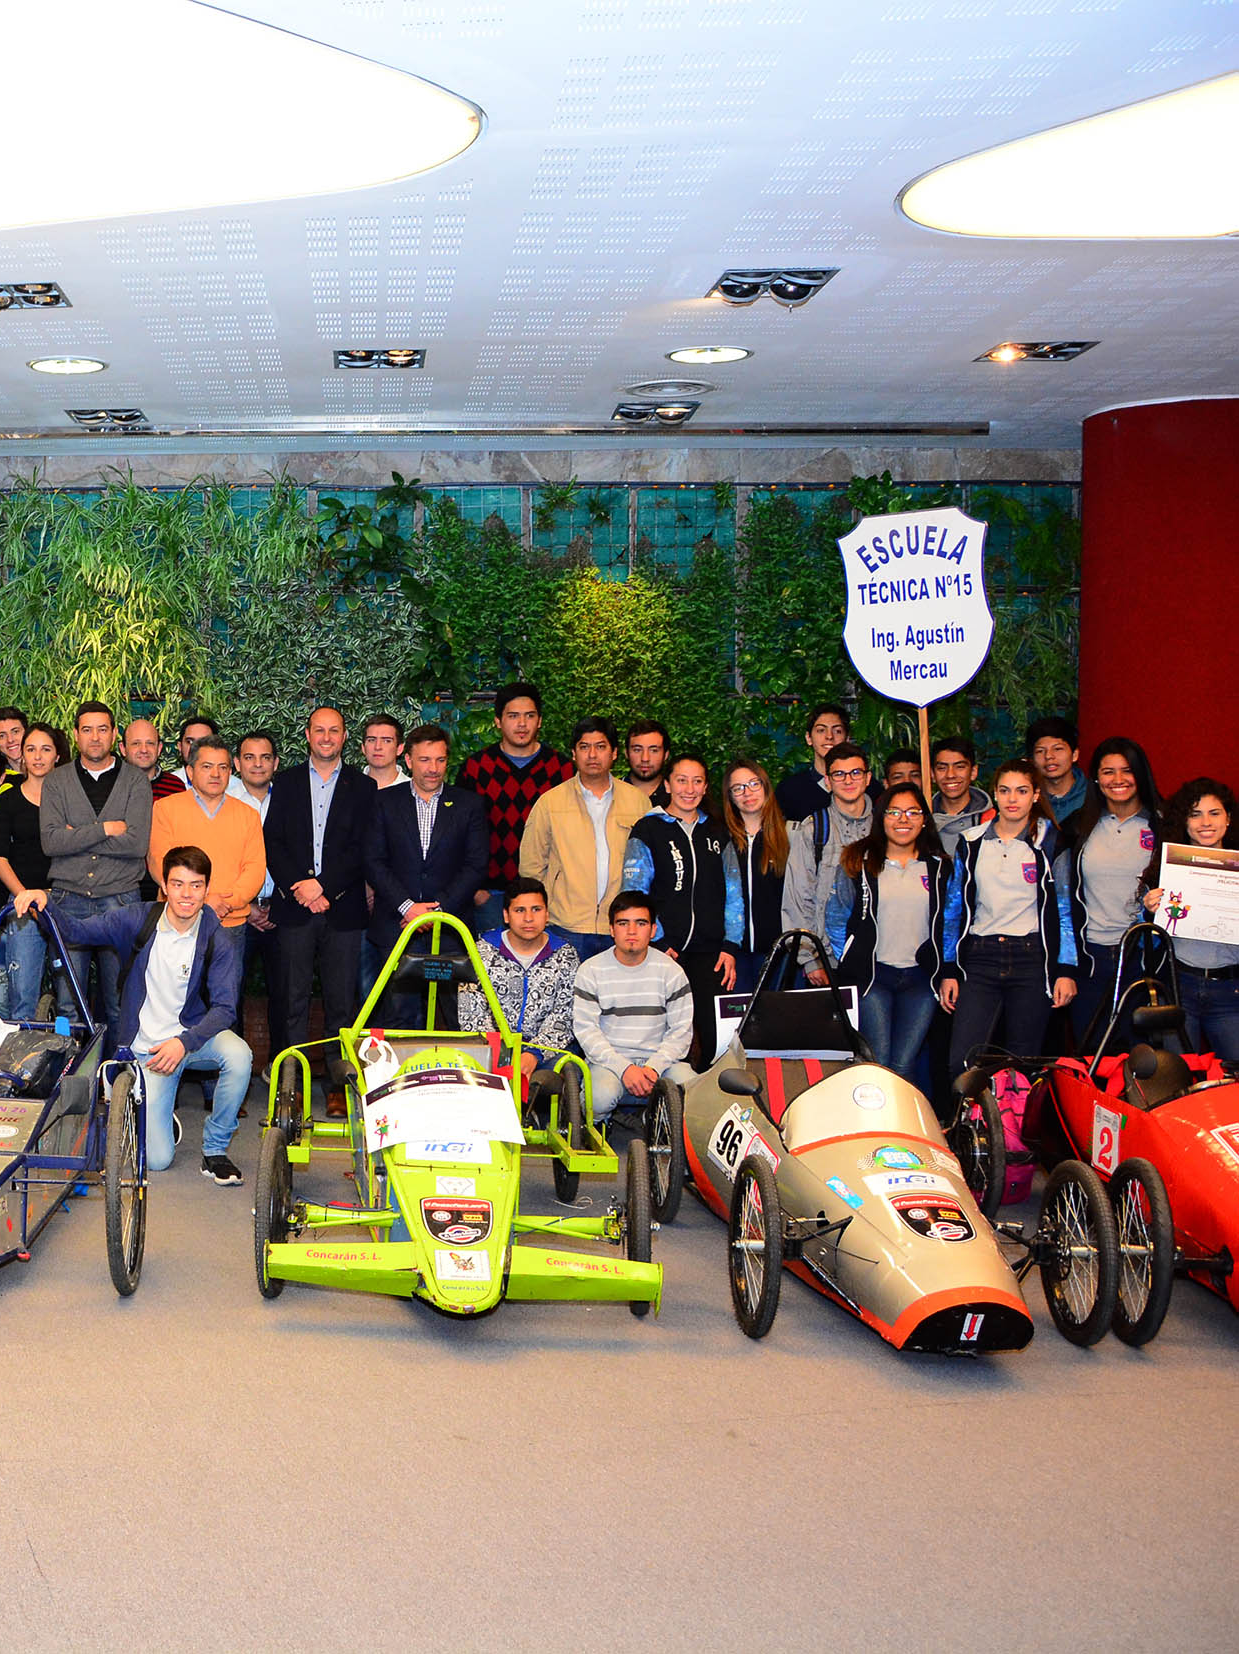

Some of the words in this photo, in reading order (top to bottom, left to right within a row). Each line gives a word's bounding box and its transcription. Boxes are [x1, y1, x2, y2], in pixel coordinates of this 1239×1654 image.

[856, 525, 968, 573] ESCUELA
[858, 577, 929, 605] TÉCNICA
[871, 627, 900, 652] Ing.
[905, 622, 965, 650] Agustín
[890, 660, 948, 680] Mercau
[706, 838, 721, 854] 16
[668, 841, 685, 891] INDUS
[716, 1119, 743, 1167] 96
[1098, 1126, 1113, 1169] 2
[306, 1249, 357, 1260] Concarán
[546, 1257, 599, 1271] Concarán
